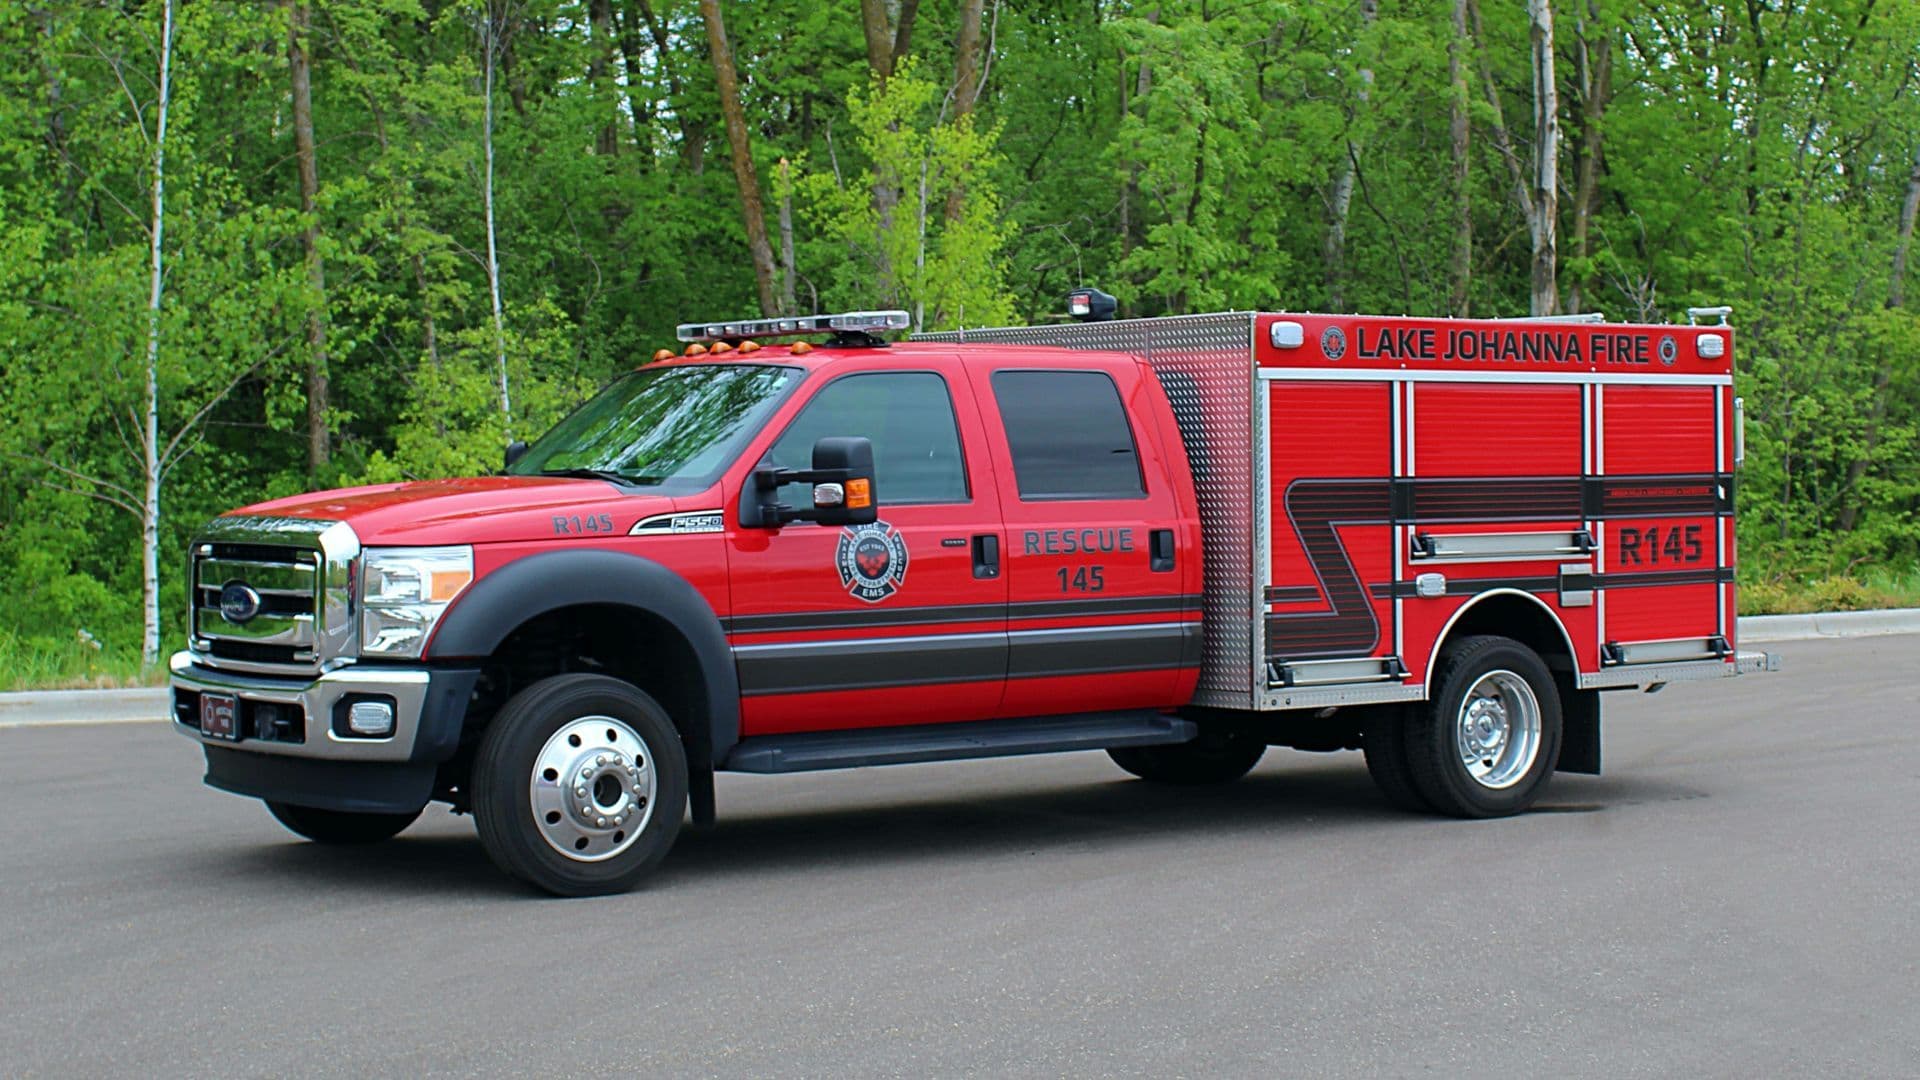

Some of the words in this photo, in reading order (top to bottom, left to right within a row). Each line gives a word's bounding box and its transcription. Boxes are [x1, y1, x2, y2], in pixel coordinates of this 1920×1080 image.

[1356, 327, 1436, 360] LAKE
[1443, 329, 1582, 363] JOHANNA
[1589, 333, 1650, 364] FIRE
[552, 513, 614, 535] R145
[857, 522, 879, 530] FIRE
[1023, 528, 1134, 555] RESCUE
[1618, 524, 1703, 565] R145
[862, 588, 884, 598] EMS
[1056, 566, 1105, 593] 145
